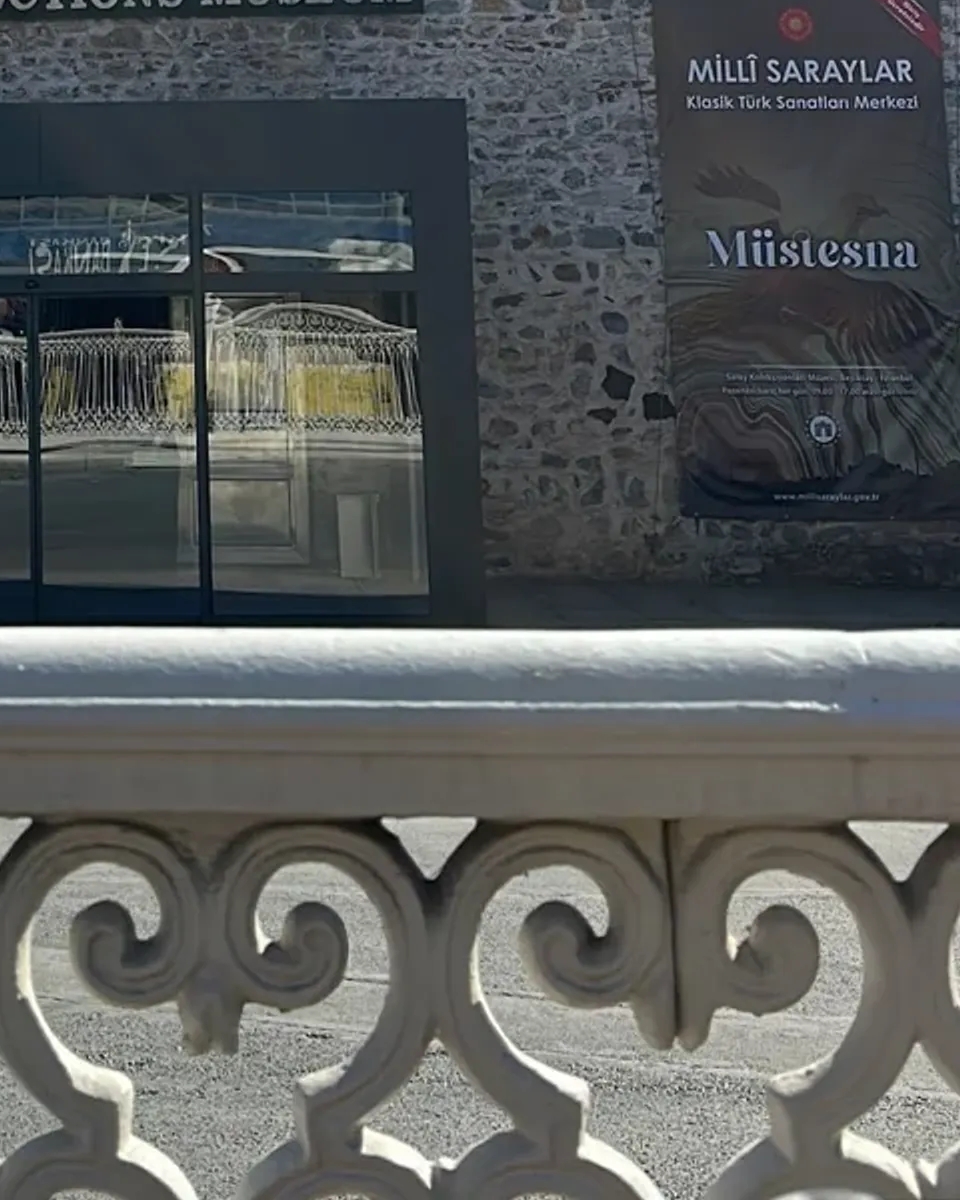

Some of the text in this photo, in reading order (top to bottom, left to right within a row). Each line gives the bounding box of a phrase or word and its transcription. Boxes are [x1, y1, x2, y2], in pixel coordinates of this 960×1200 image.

[688, 53, 914, 84] MİLLÎ SARAYLAR
[686, 95, 735, 110] Klasik
[737, 95, 772, 110] Türk
[854, 95, 919, 110] Merkezi
[705, 228, 919, 269] Müstesna
